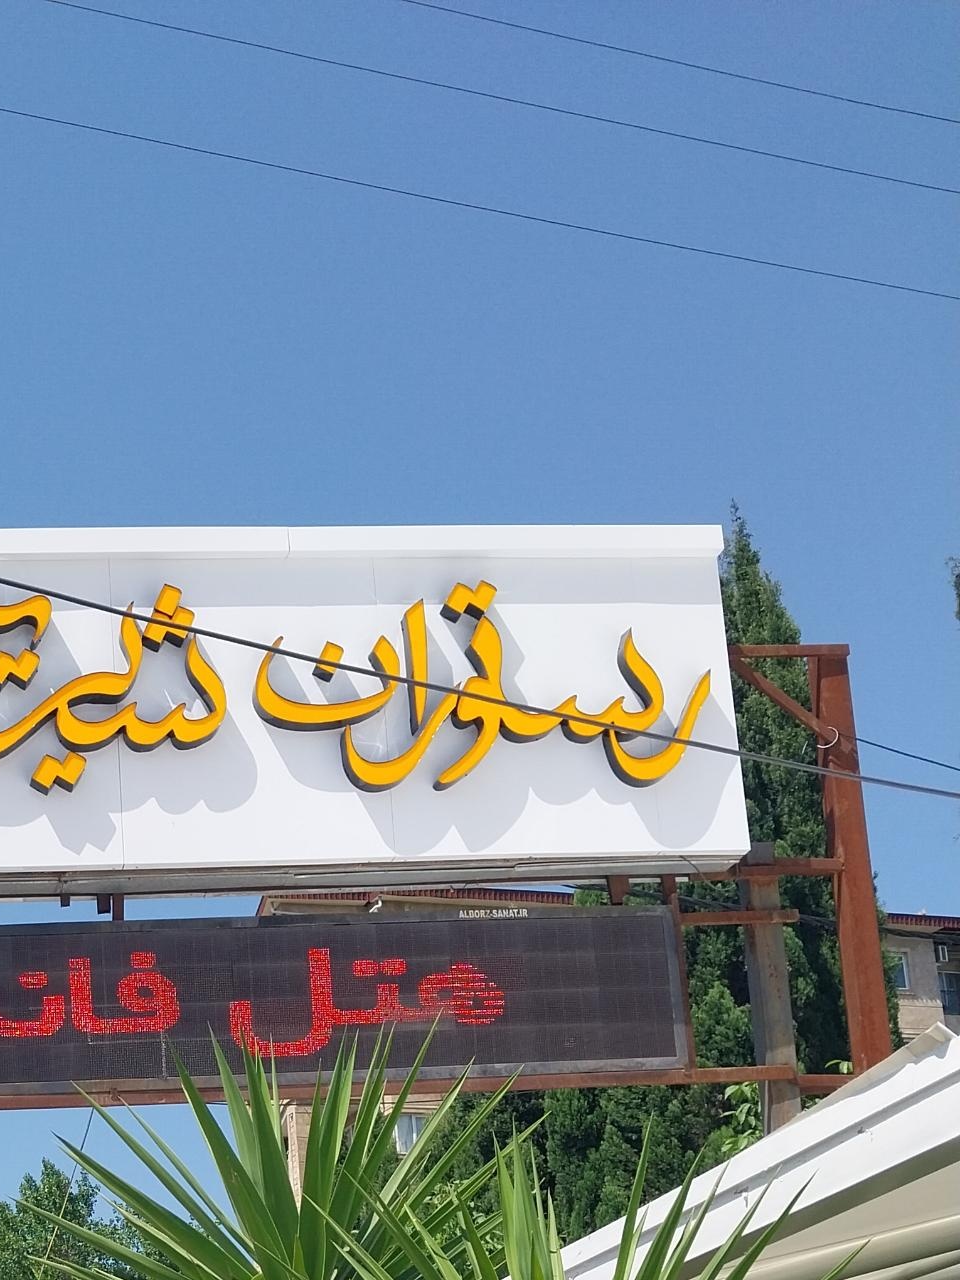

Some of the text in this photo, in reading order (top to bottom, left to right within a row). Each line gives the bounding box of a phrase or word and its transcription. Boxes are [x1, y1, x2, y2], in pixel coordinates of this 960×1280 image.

[253, 579, 712, 792] رستوران
[458, 908, 529, 919] ALBORZ-SANAT.IR
[227, 946, 506, 1060] هتل
